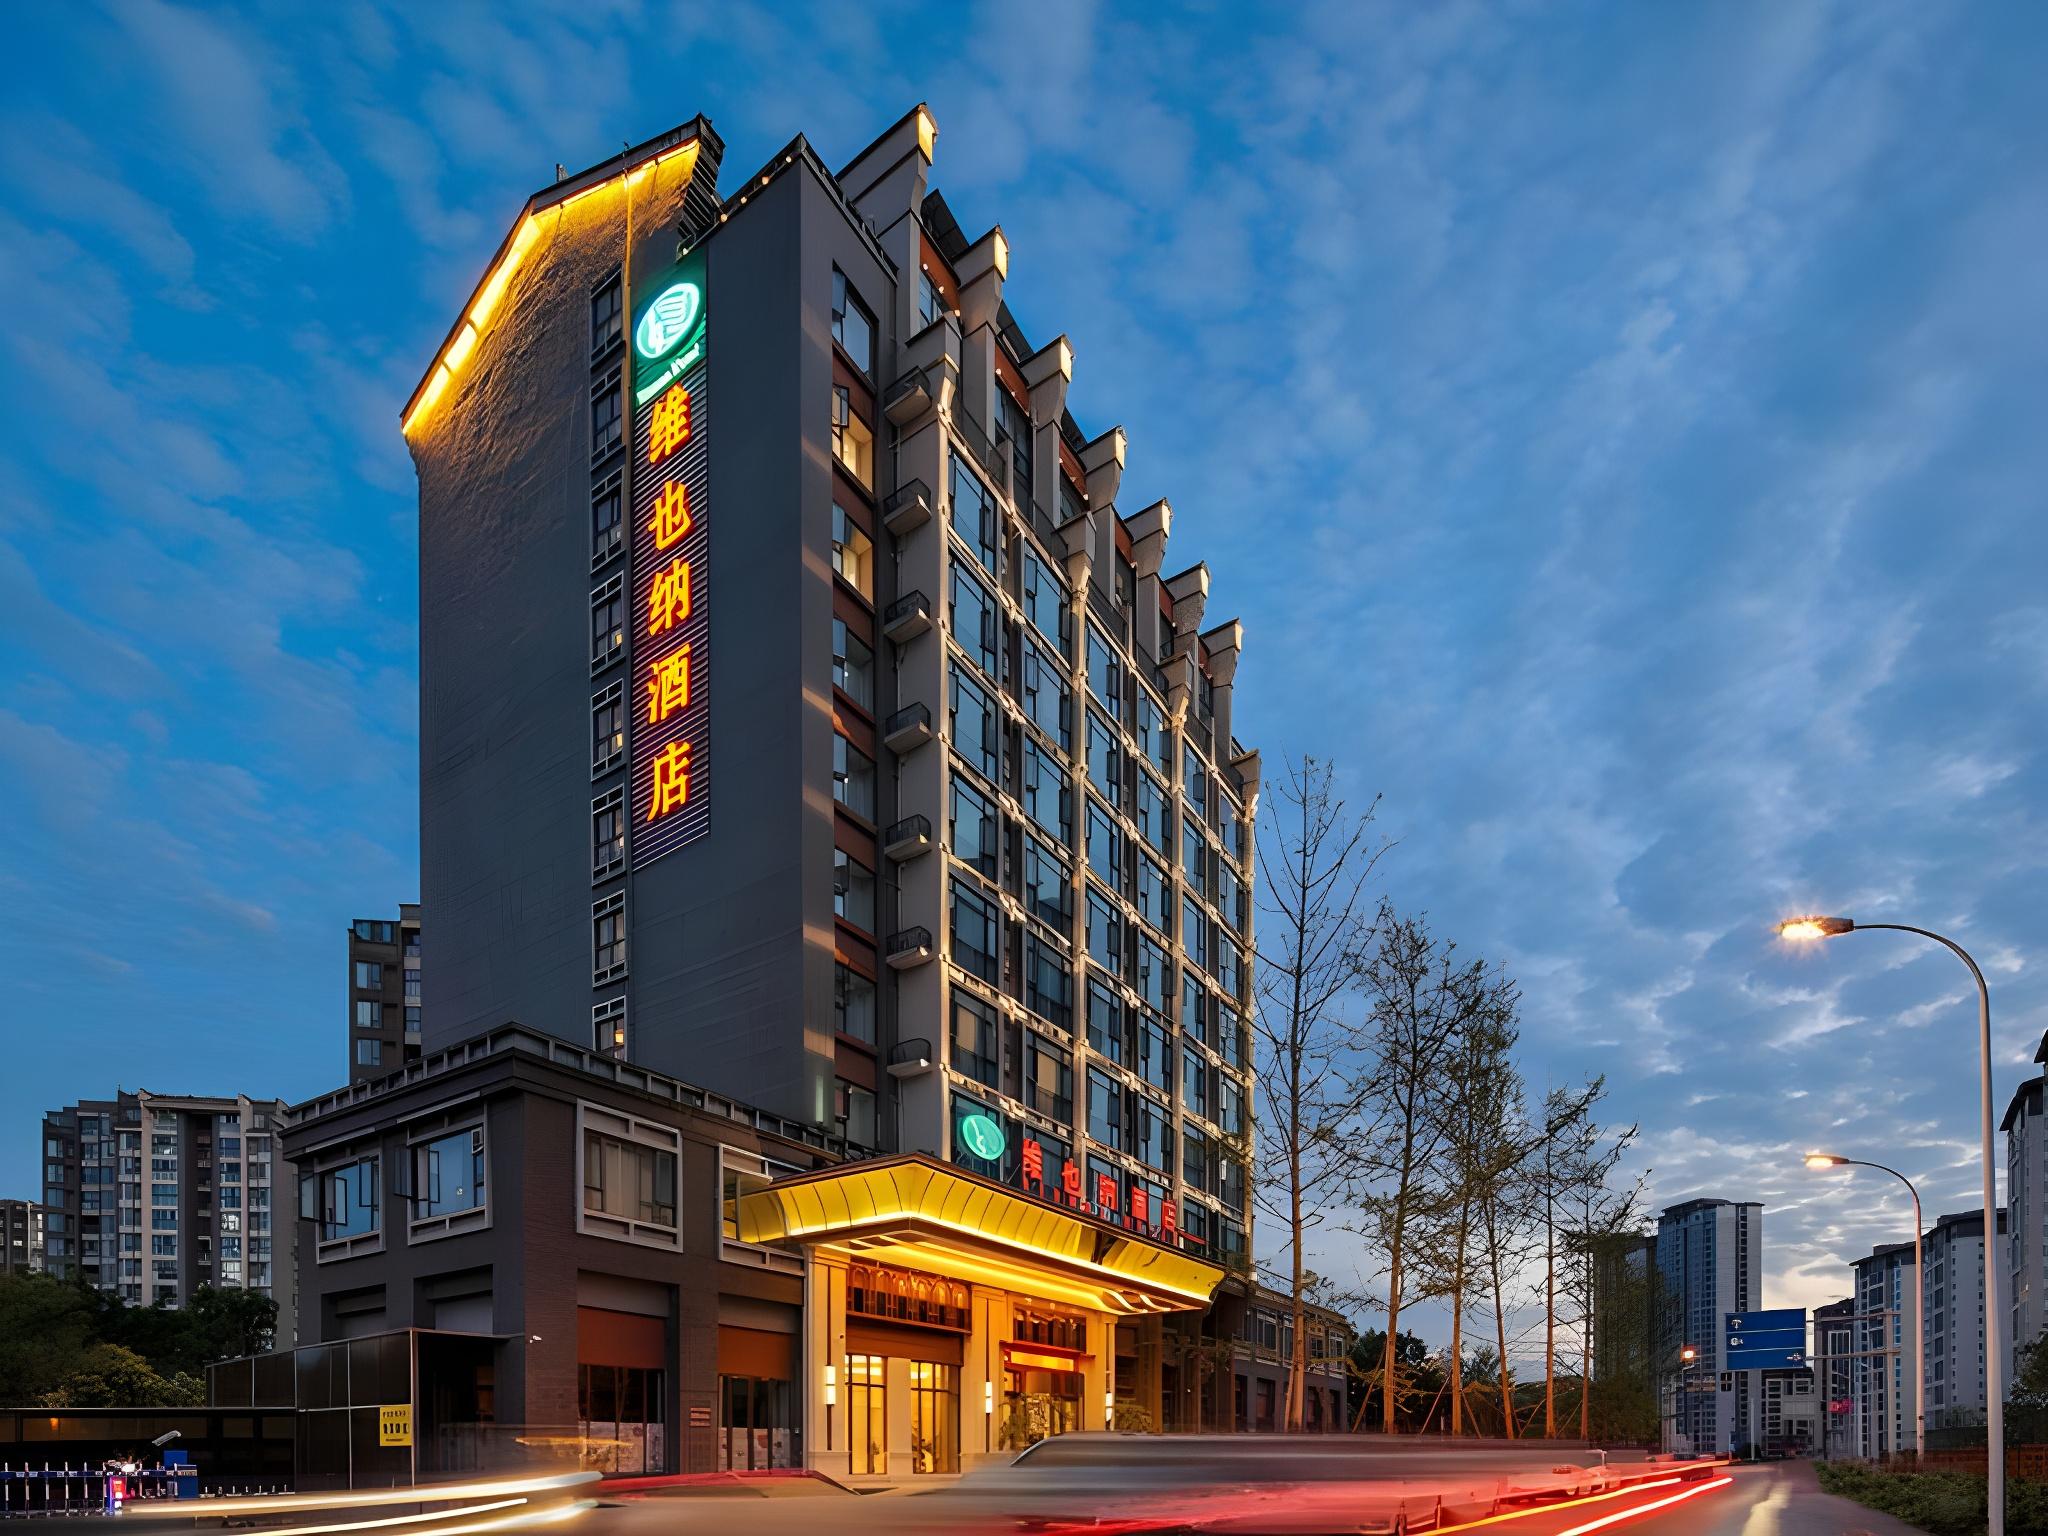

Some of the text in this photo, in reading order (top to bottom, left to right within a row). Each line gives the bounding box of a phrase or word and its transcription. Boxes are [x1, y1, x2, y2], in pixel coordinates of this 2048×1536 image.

[647, 383, 692, 821] 维也纳酒店
